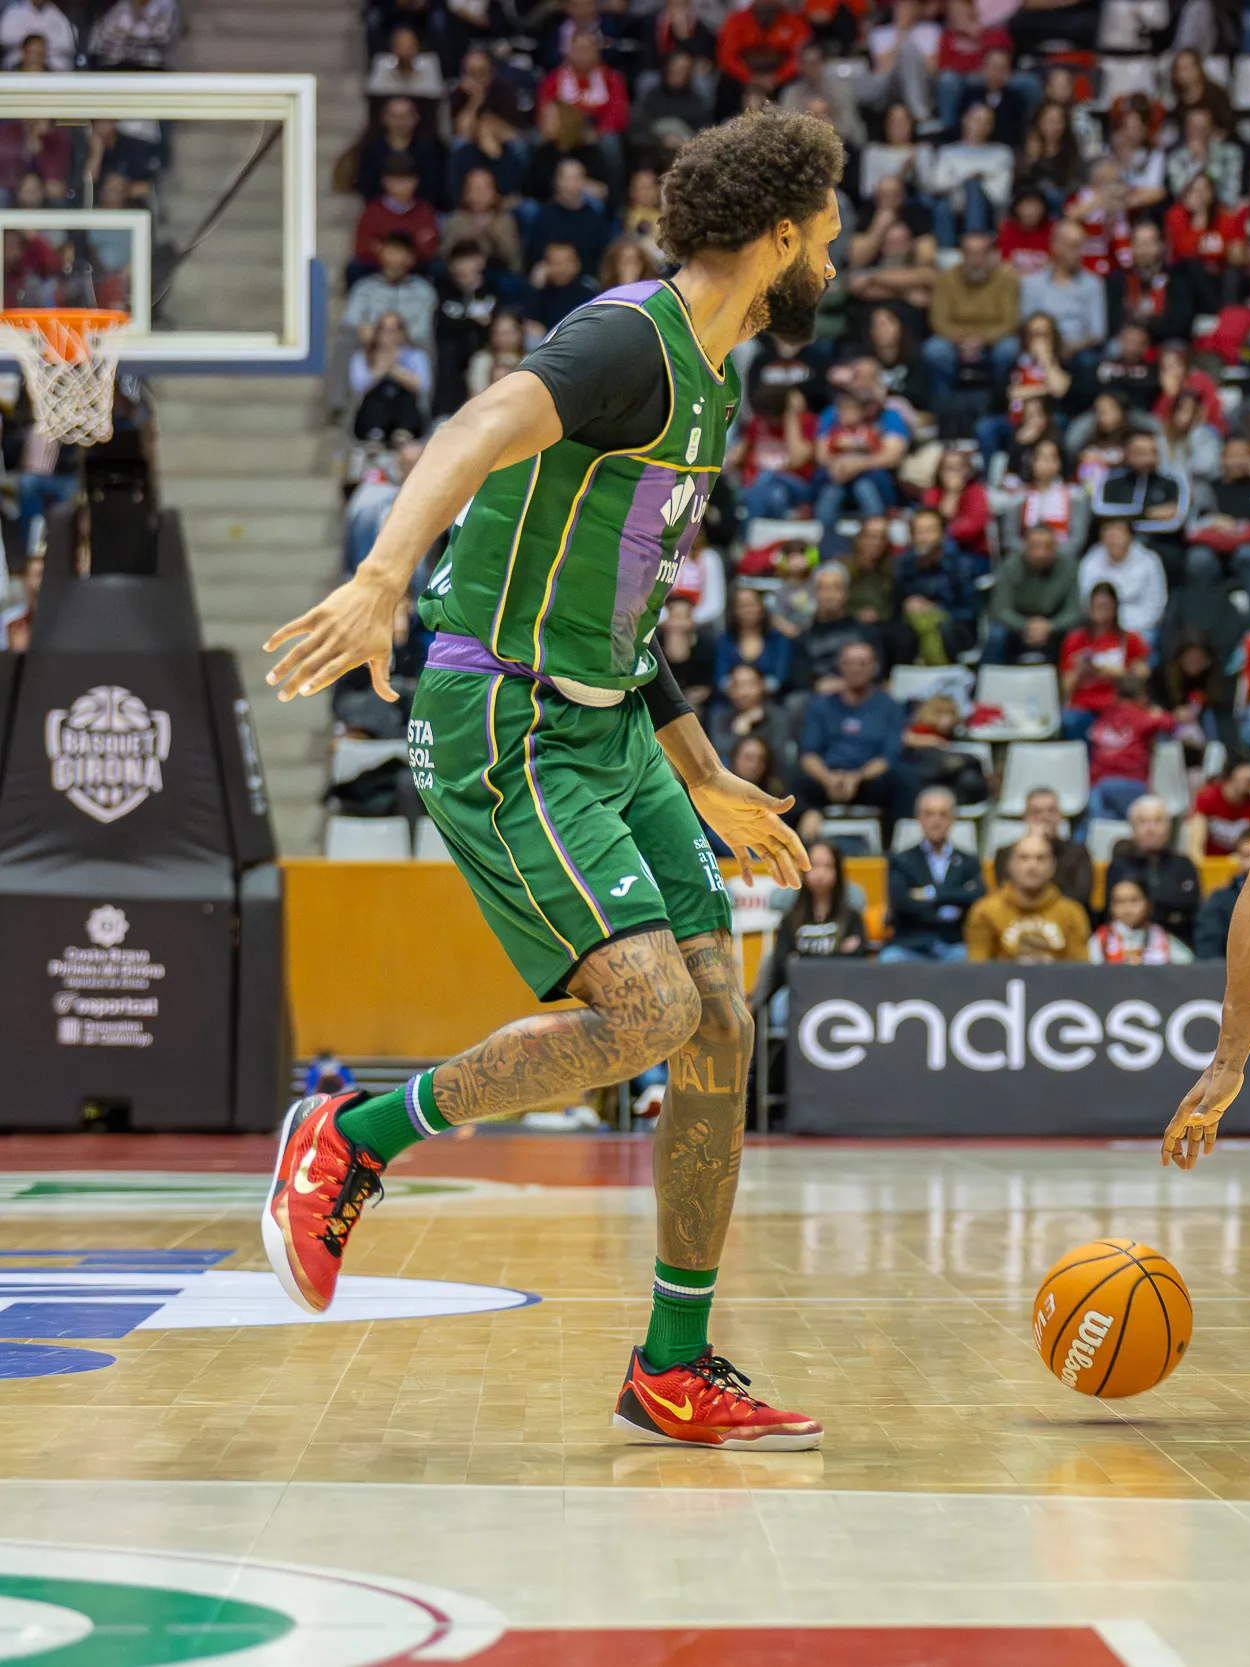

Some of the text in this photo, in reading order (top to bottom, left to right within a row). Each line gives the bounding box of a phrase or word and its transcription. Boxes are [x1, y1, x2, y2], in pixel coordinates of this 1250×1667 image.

[51, 754, 164, 794] GIRONA
[409, 747, 435, 769] SOL
[799, 978, 1224, 1071] endesa
[1061, 1310, 1114, 1388] Wilson
